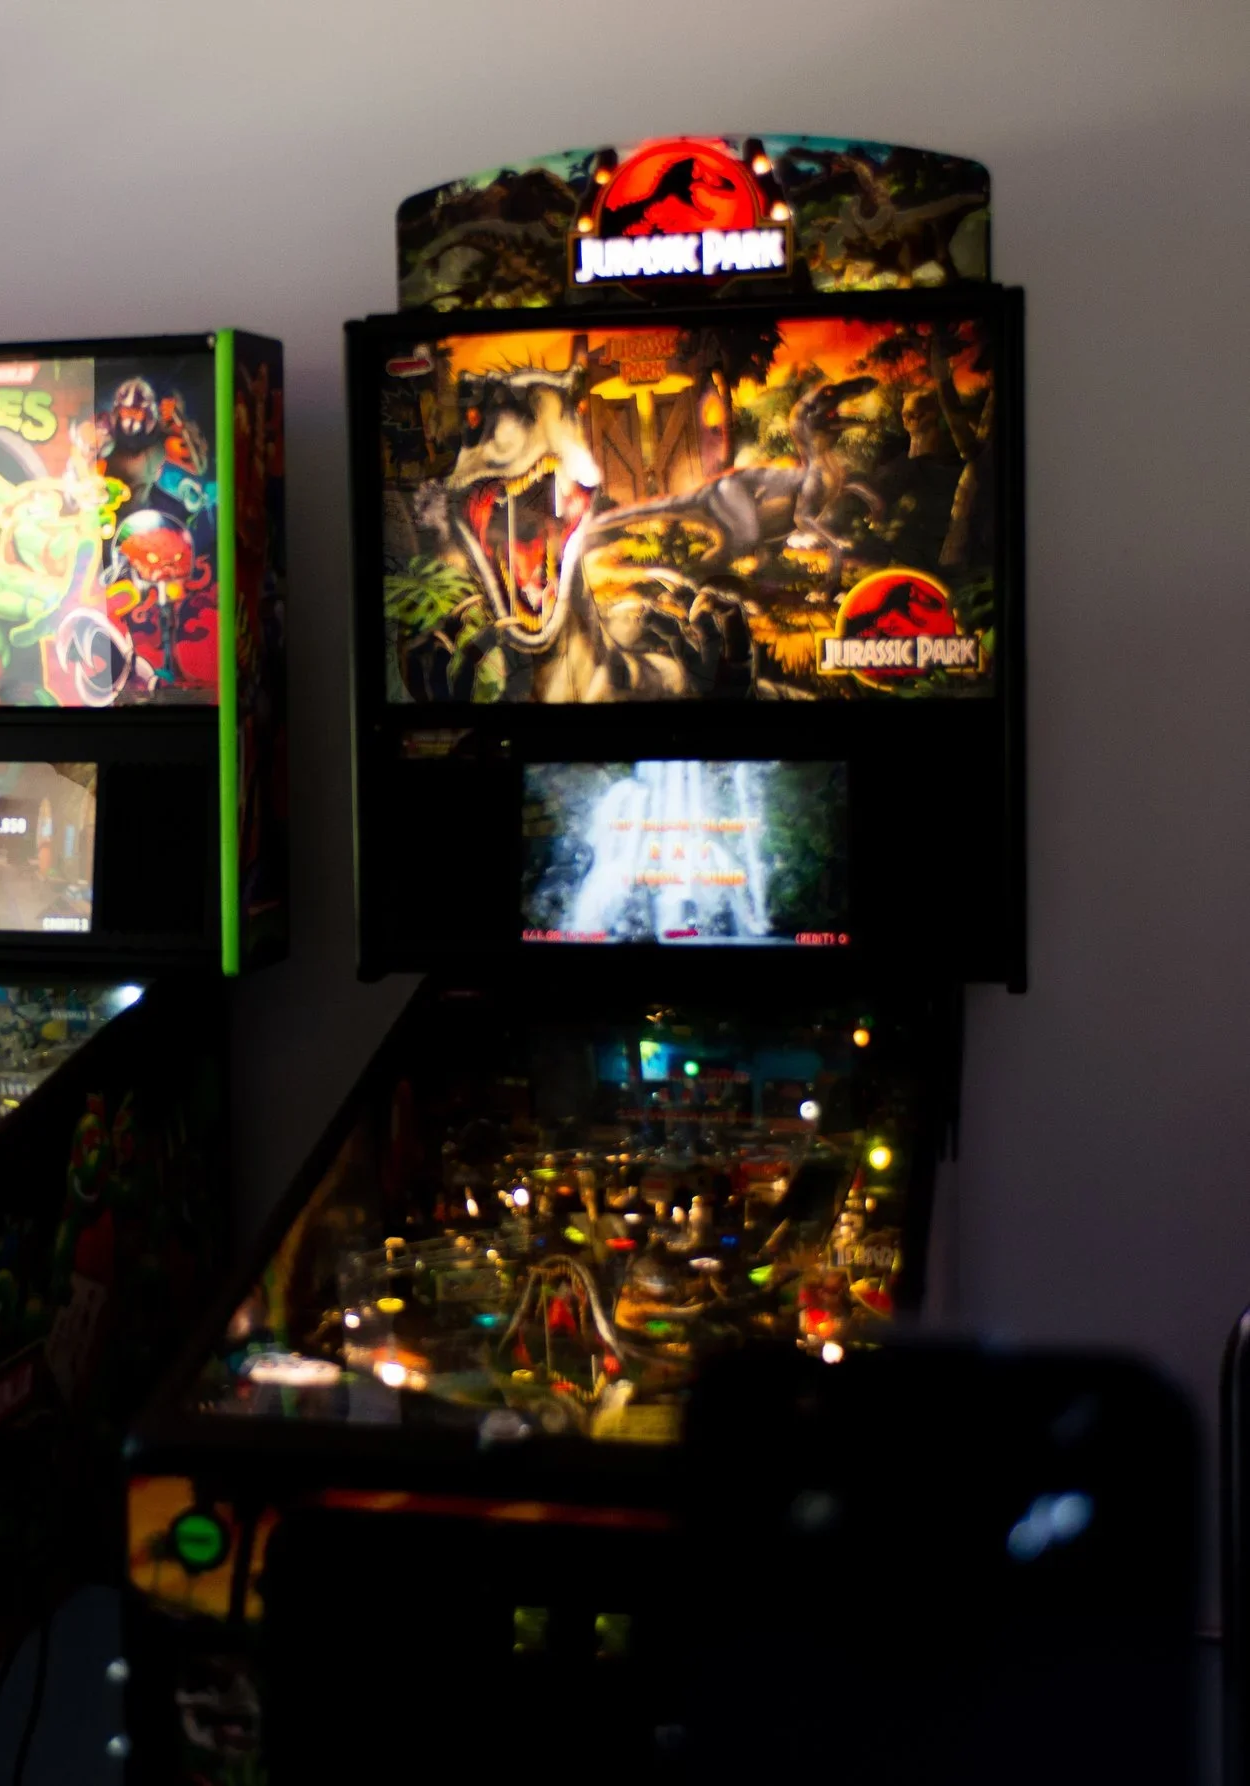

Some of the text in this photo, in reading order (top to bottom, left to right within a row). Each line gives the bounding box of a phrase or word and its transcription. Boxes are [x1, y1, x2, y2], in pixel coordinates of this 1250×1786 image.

[702, 229, 784, 276] PARK
[821, 632, 977, 670] JURASSIC PARK
[795, 932, 836, 945] CREDITS
